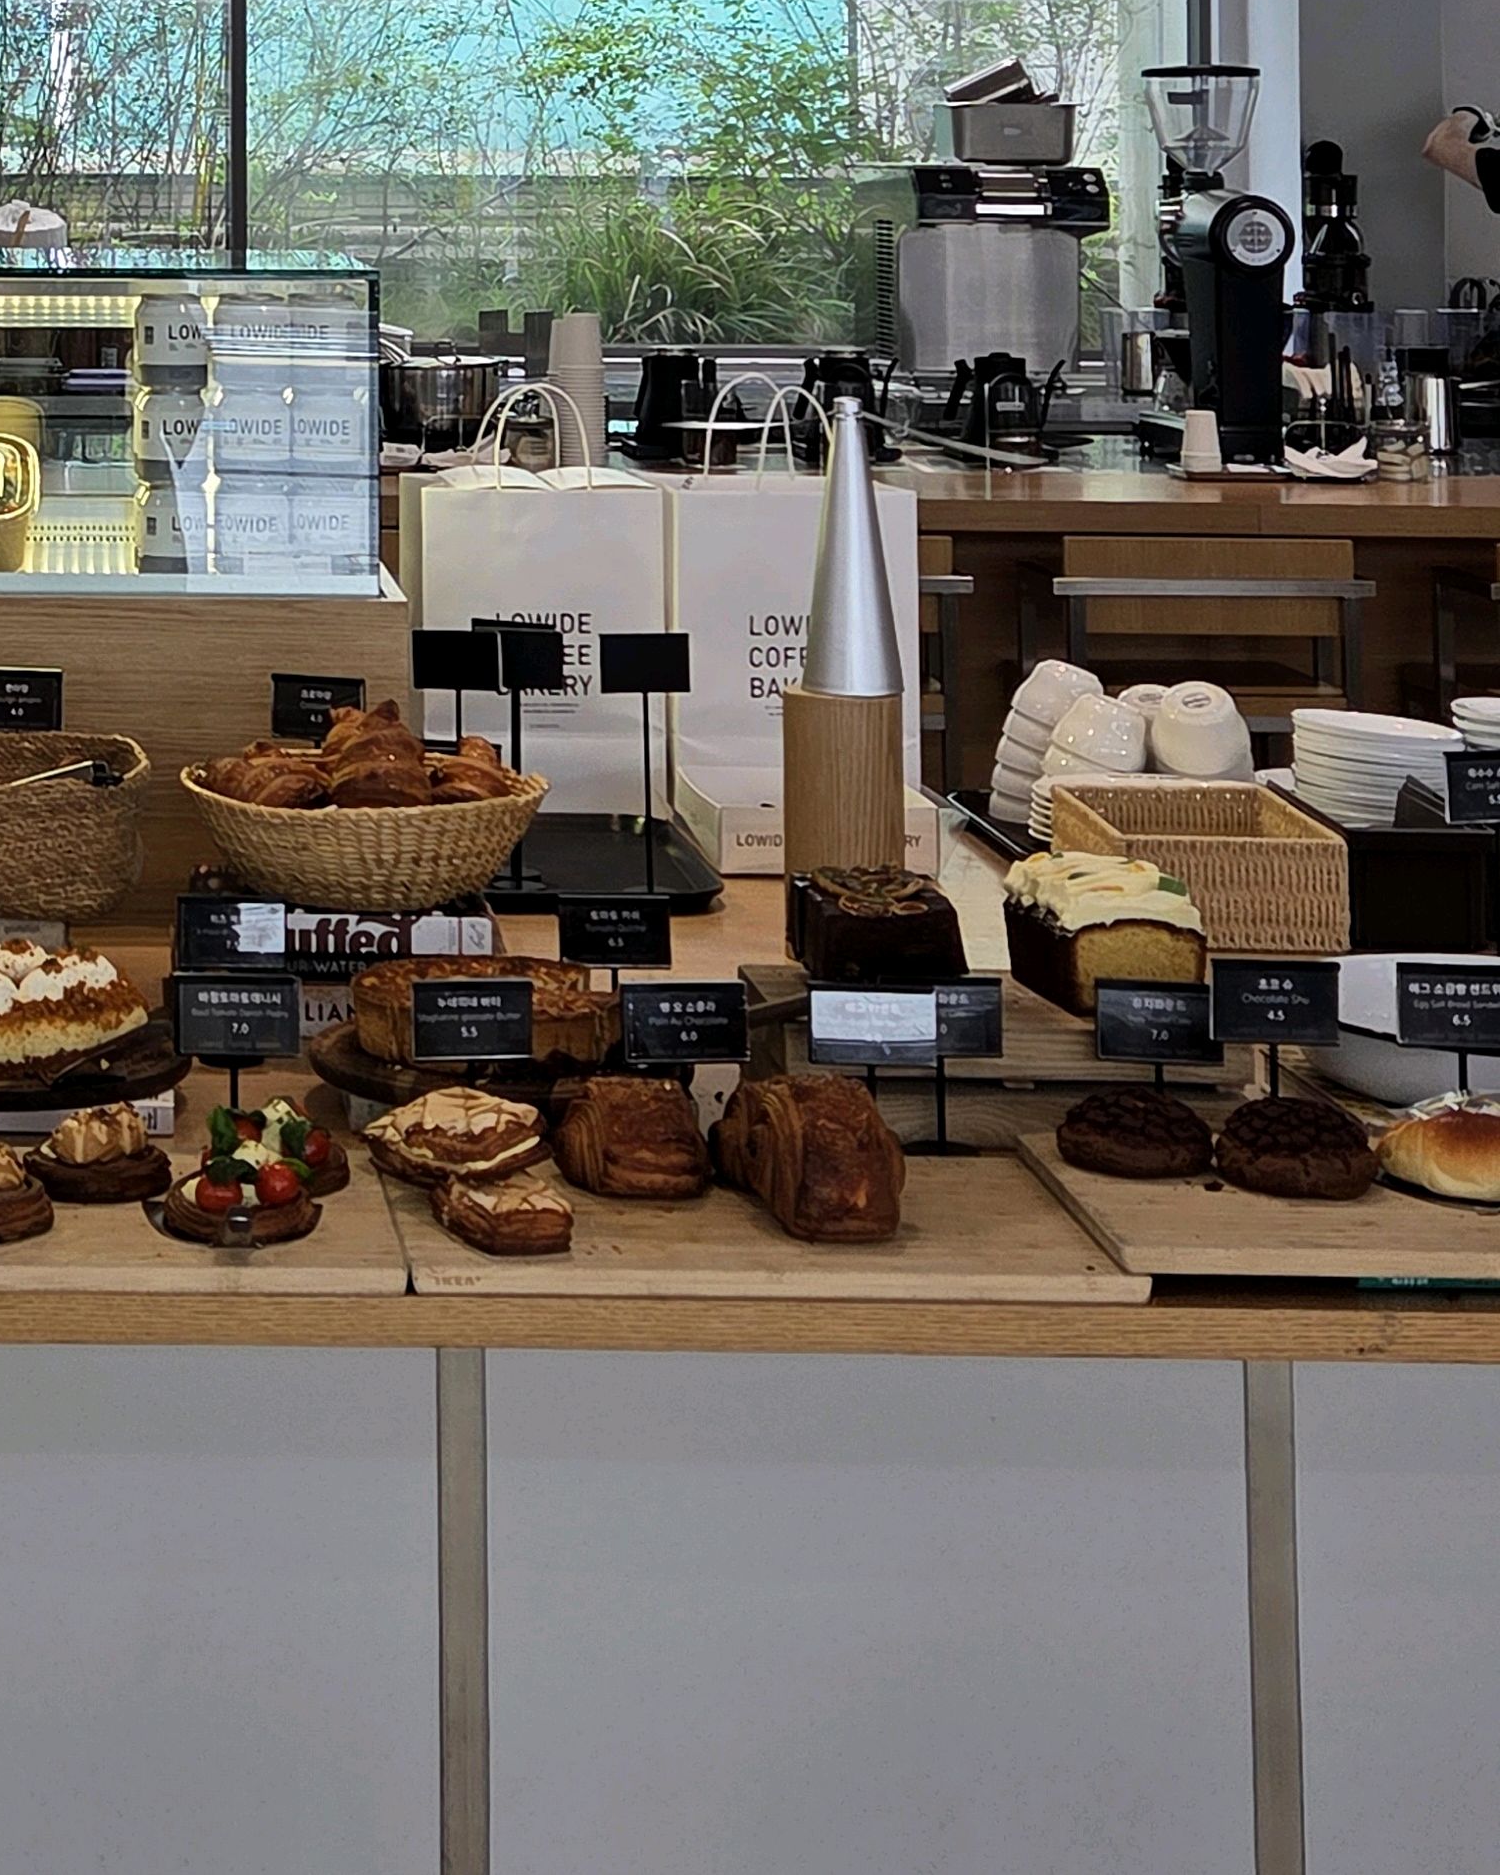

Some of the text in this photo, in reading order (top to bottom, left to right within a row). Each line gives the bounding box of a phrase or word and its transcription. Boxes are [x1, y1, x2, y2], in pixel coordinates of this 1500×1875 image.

[163, 419, 201, 435] LOW
[749, 615, 811, 636] LOWI
[736, 833, 784, 848] LOWID
